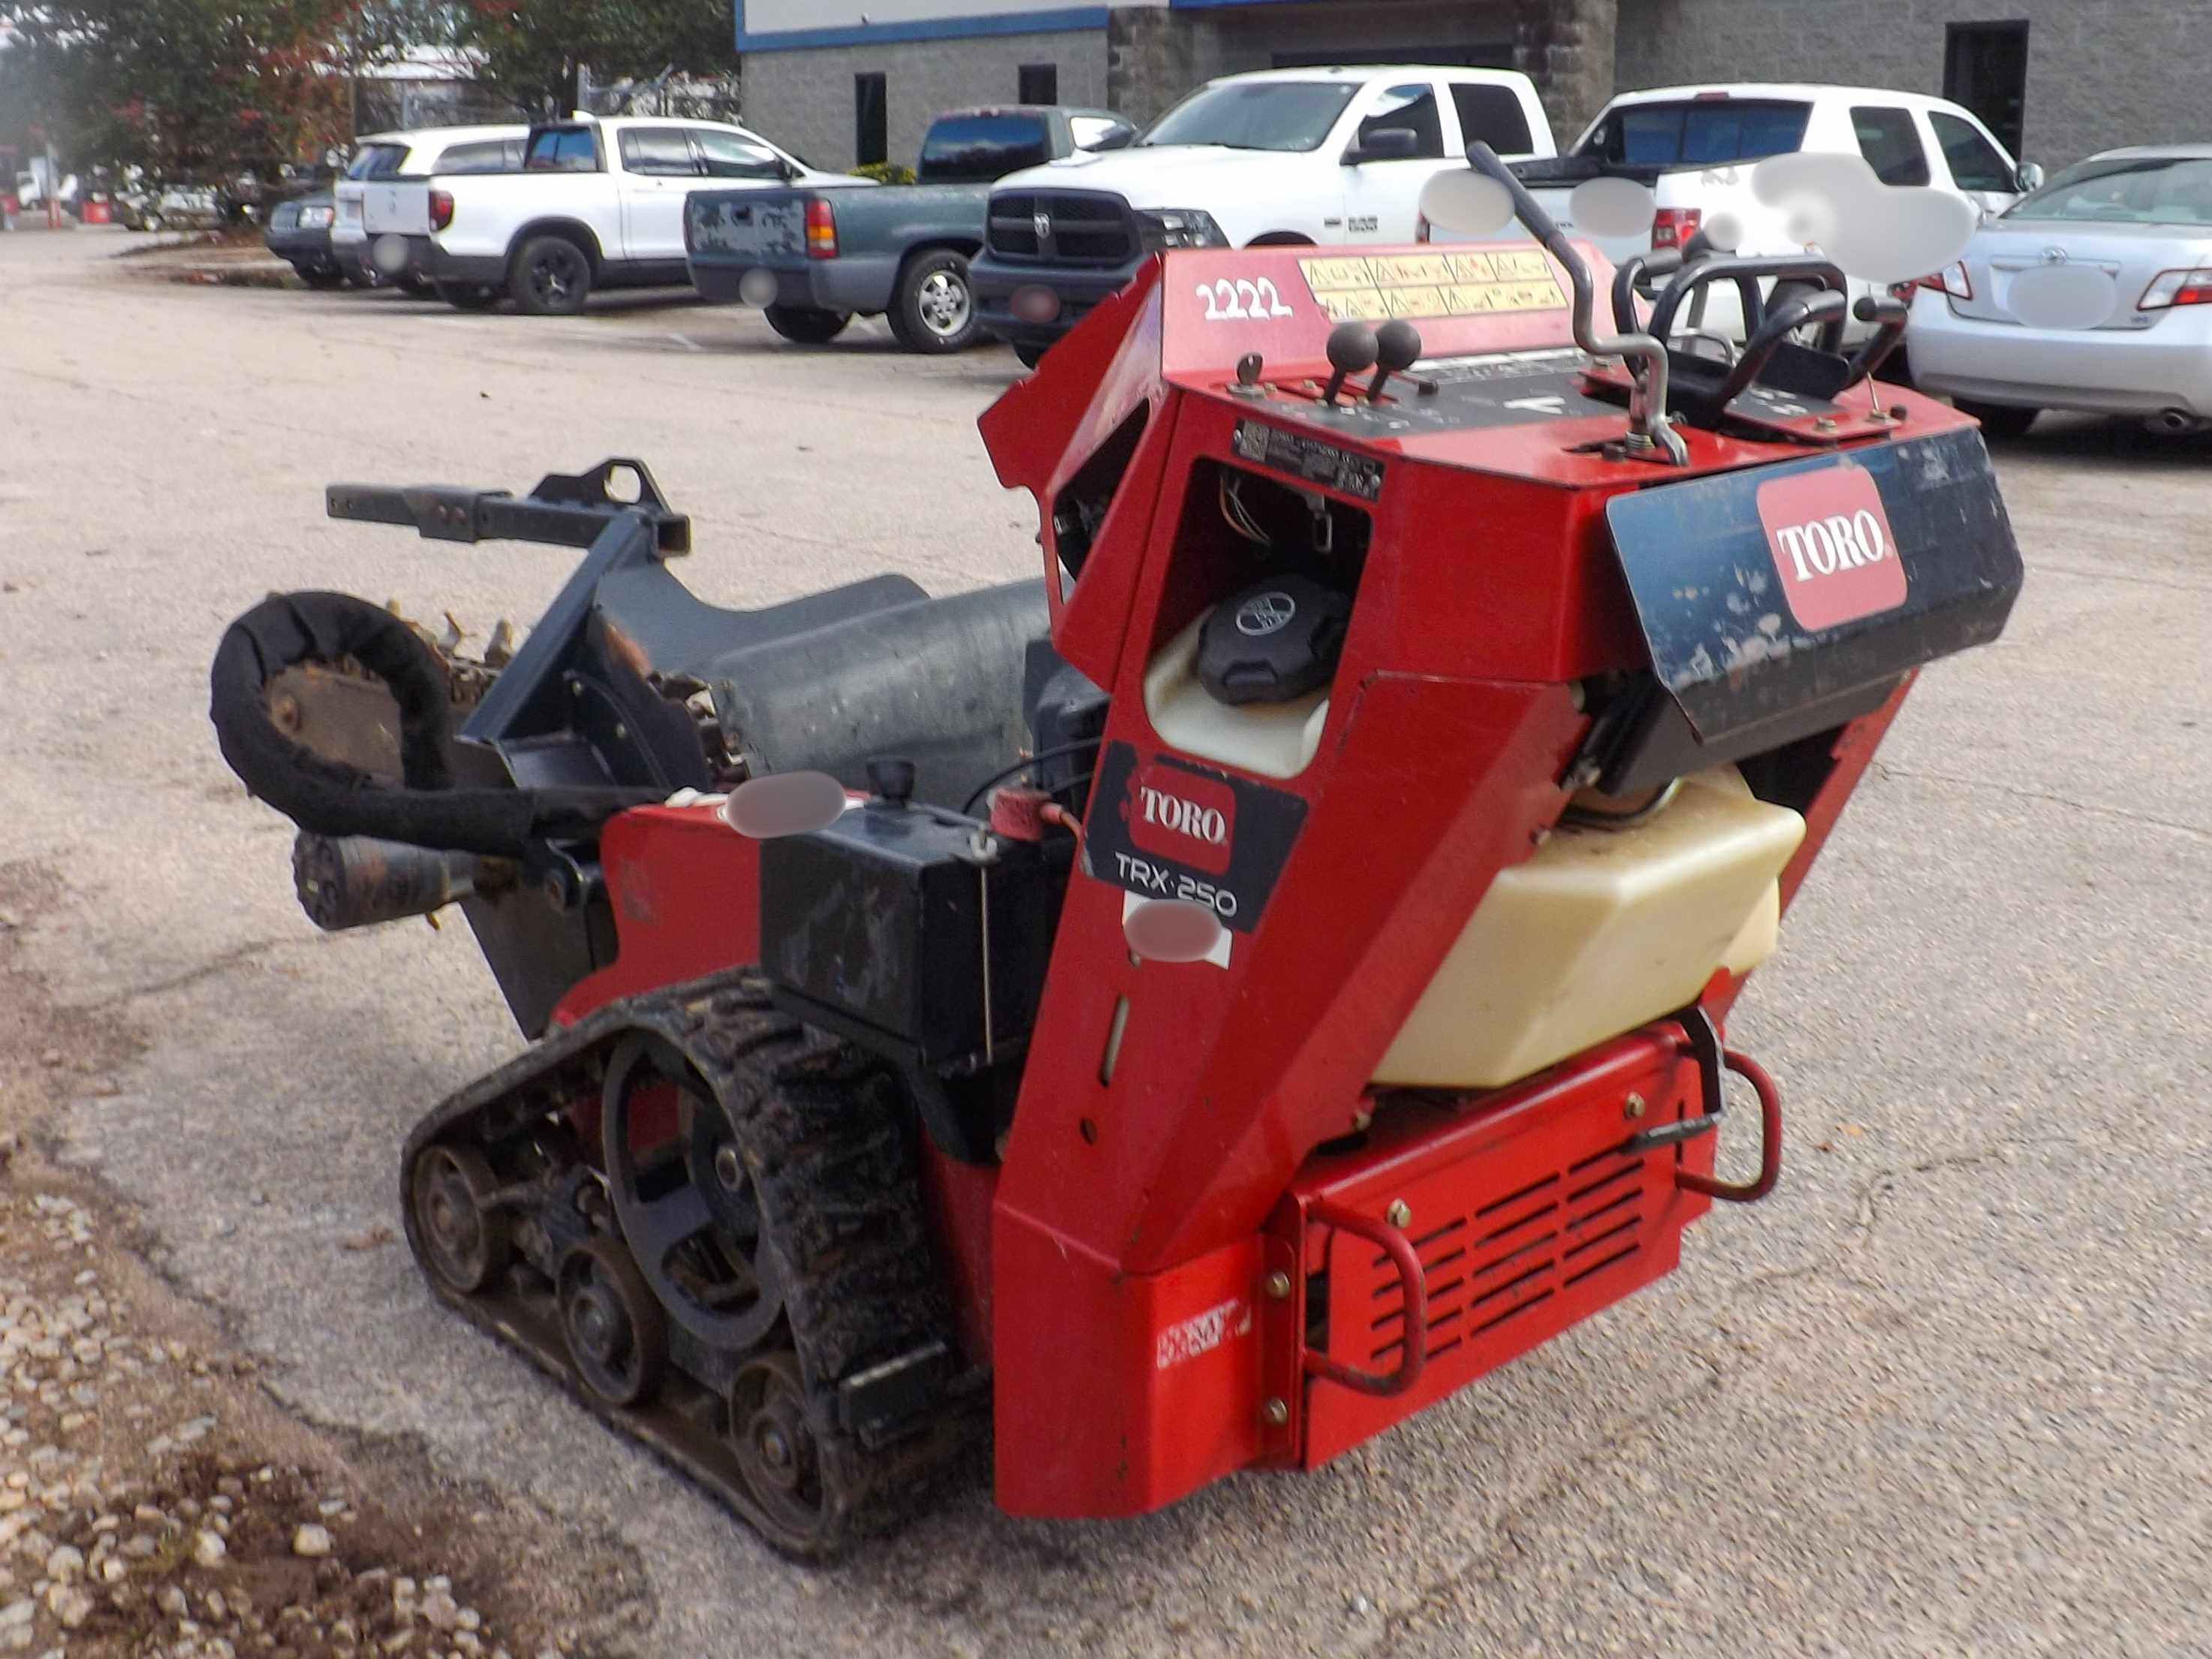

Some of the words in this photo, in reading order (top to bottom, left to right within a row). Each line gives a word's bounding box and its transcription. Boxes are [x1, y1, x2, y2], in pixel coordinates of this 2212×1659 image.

[1195, 276, 1294, 321] 2222
[1777, 509, 1884, 583] TORO
[1141, 786, 1226, 844] TORO
